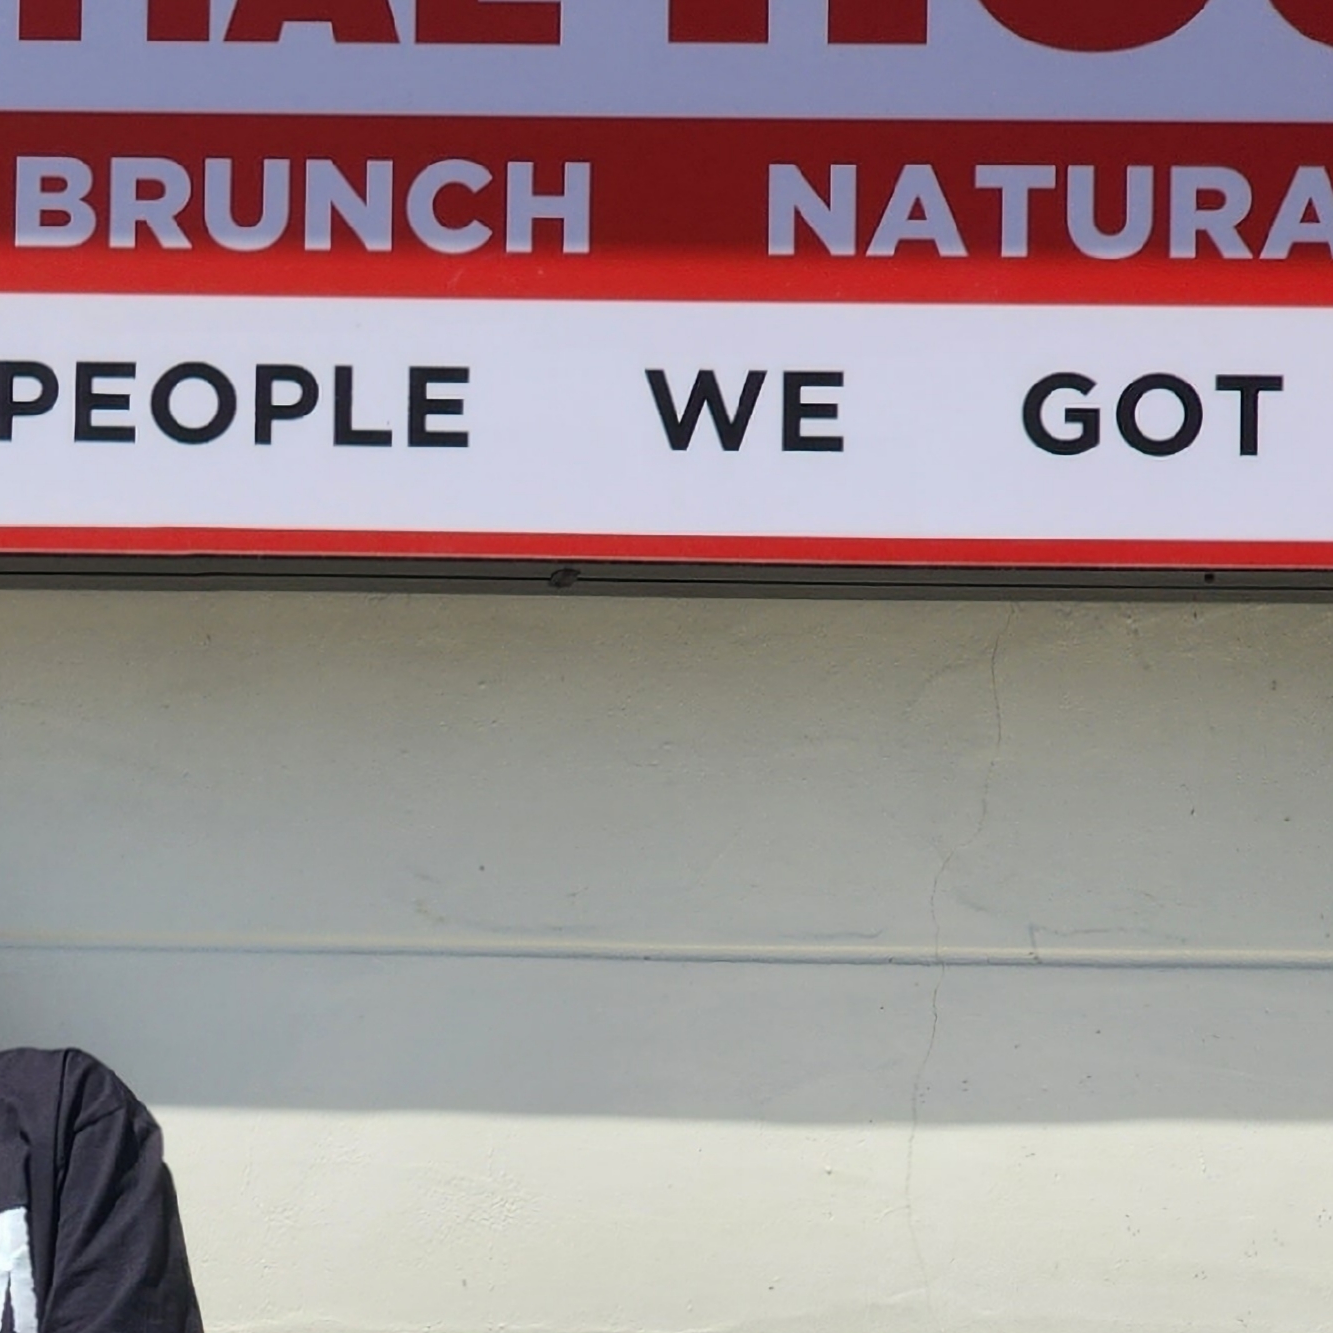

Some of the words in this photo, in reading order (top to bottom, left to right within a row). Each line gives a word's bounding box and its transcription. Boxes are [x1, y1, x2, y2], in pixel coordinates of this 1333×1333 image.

[13, 154, 592, 255] BRUNCH
[766, 162, 1333, 260] NATURA
[644, 368, 845, 453] WE
[1021, 371, 1285, 458] GOT
